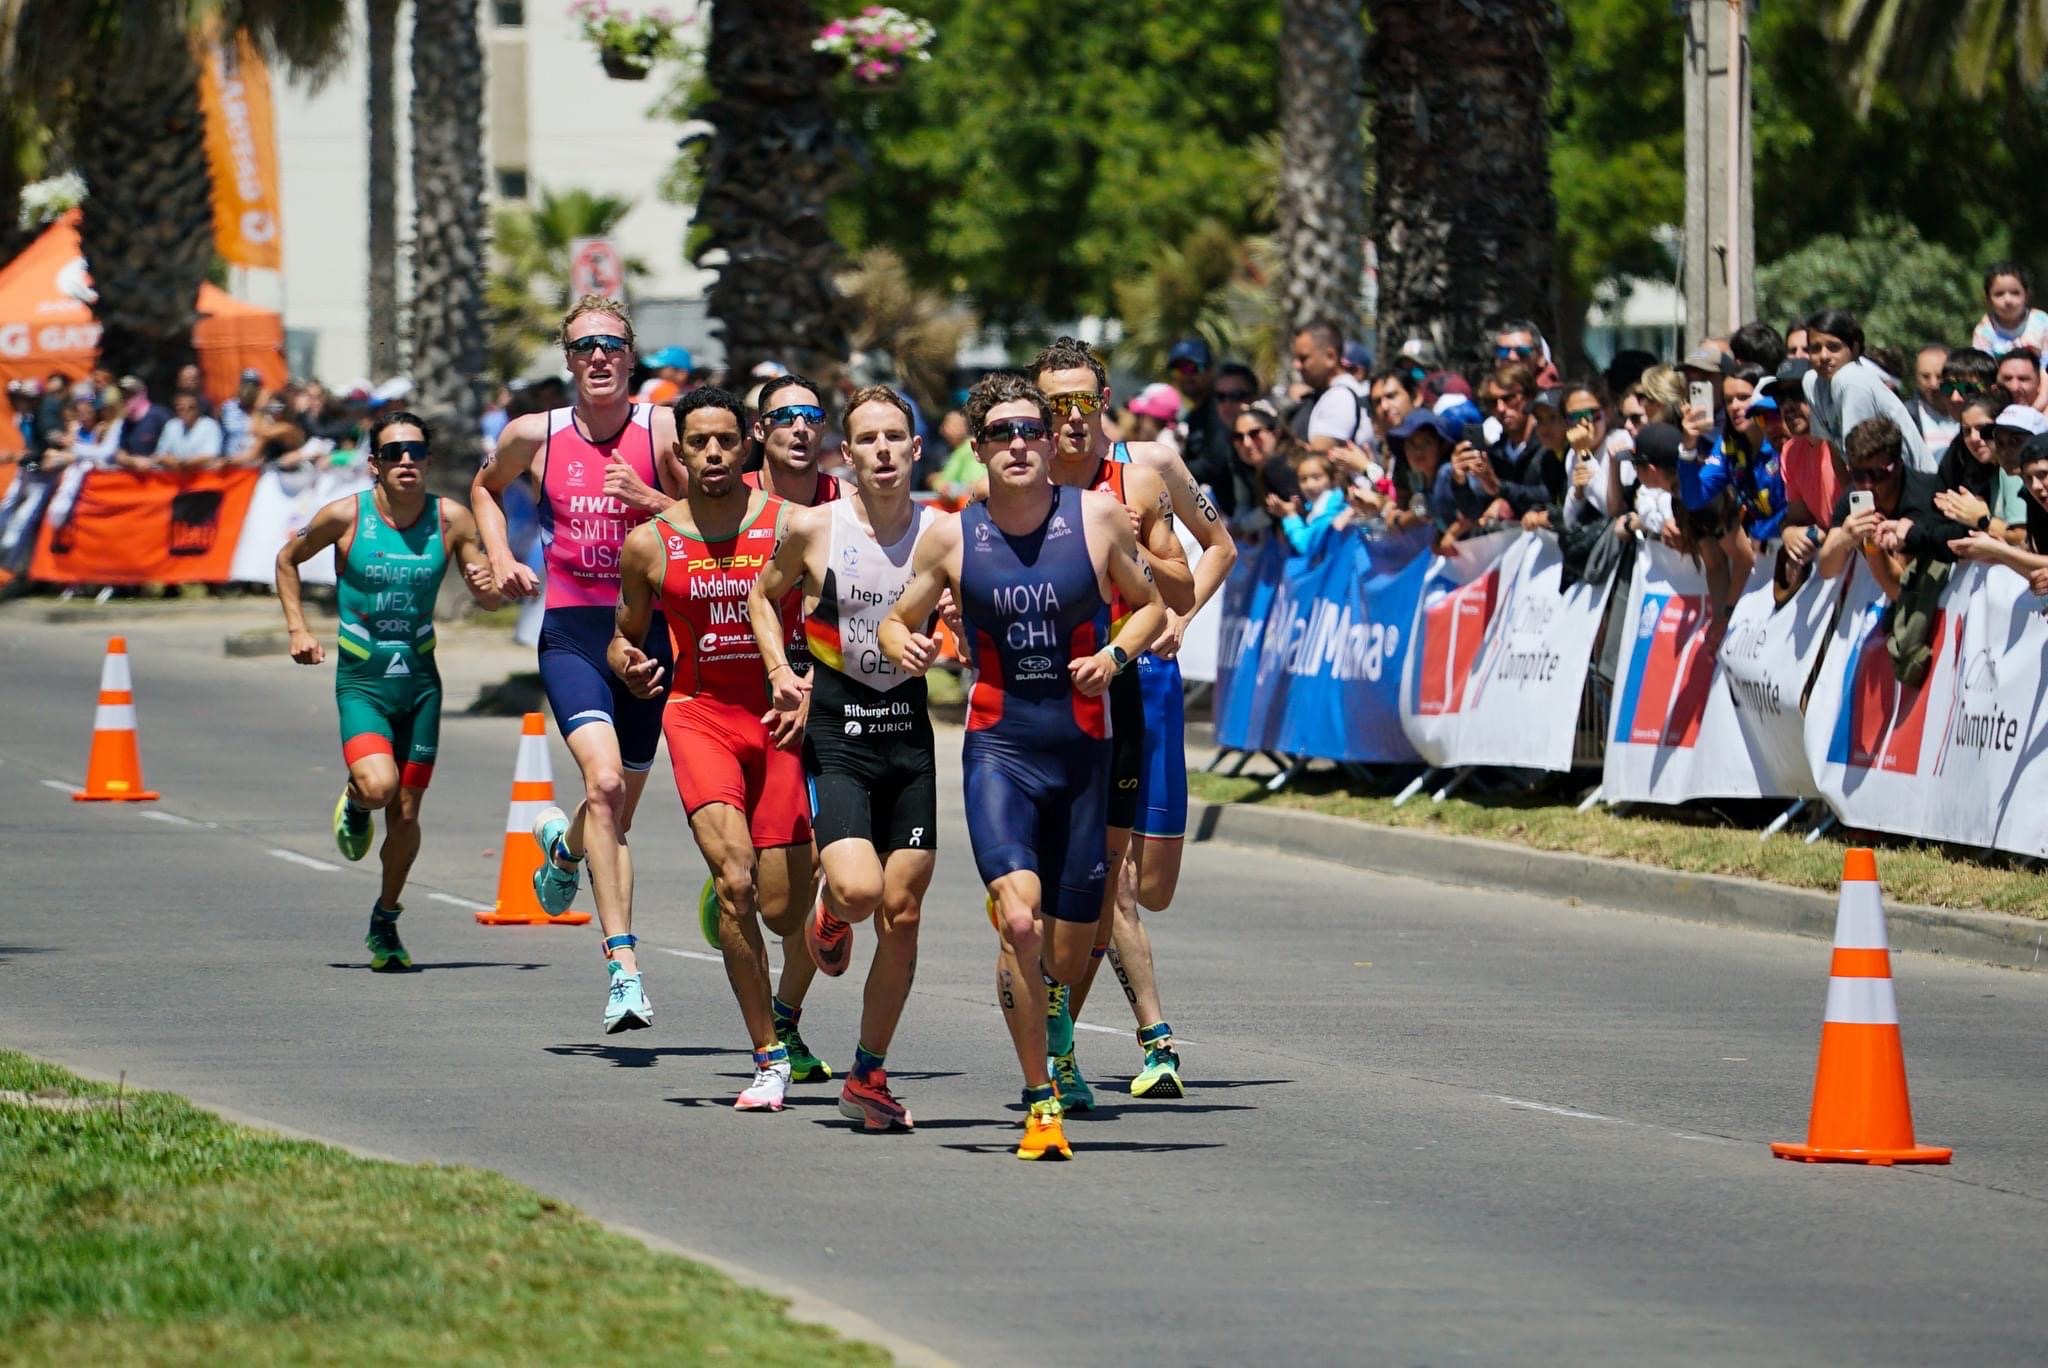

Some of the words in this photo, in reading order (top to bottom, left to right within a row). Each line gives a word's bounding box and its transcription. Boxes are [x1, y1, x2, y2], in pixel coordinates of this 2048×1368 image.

[570, 519, 637, 540] SMITH
[688, 554, 763, 572] POISSY
[376, 591, 415, 612] MEX
[851, 585, 883, 606] hep
[993, 582, 1060, 616] MOYA
[710, 601, 750, 625] MAR
[1007, 619, 1057, 650] CHI
[1015, 673, 1058, 681] SUBARU
[868, 722, 913, 733] ZURICH
